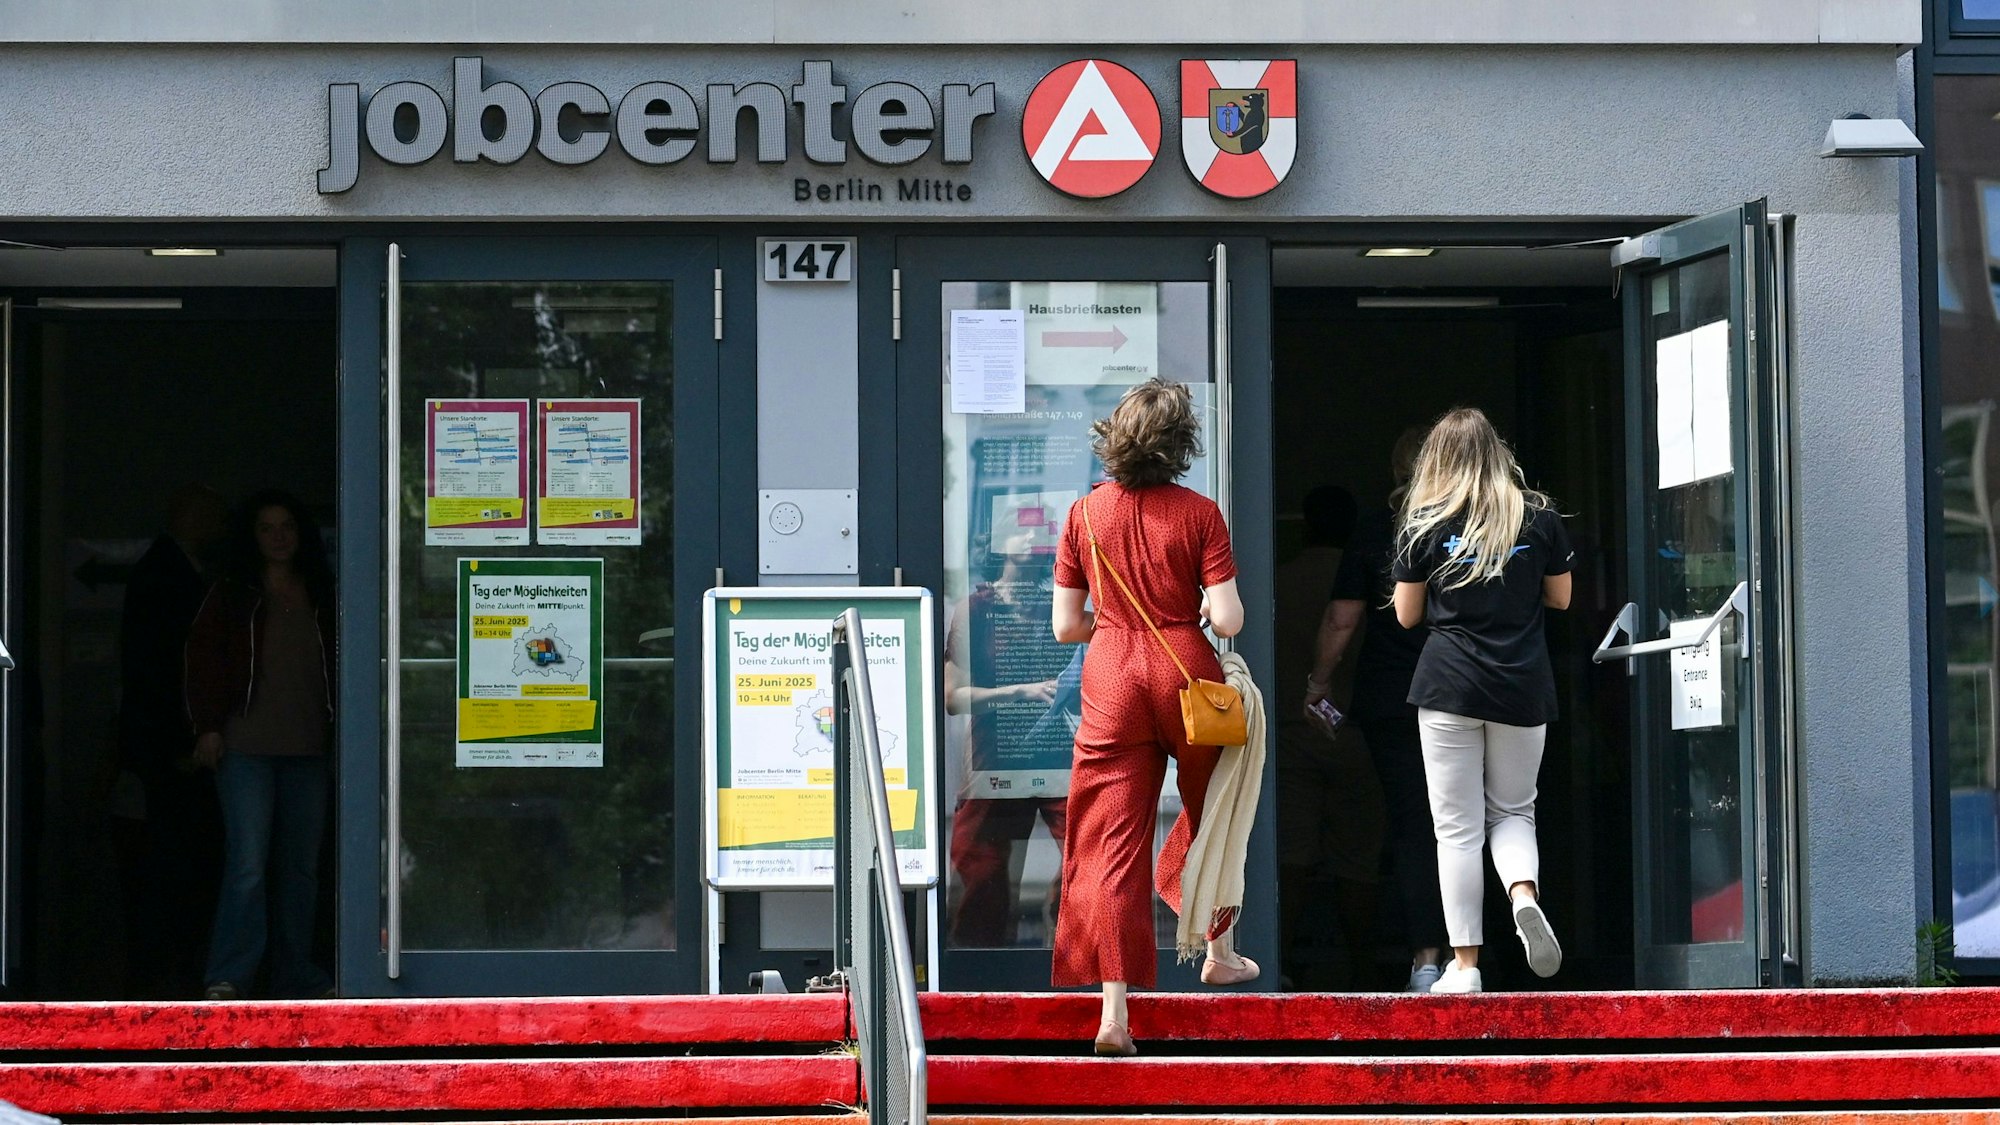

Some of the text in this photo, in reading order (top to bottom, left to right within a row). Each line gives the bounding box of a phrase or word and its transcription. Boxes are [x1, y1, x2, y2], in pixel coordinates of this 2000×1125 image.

[317, 56, 996, 193] jobcenter
[794, 179, 972, 202] Berlin Mitte
[770, 243, 845, 279] 147
[1029, 303, 1142, 315] Hausbriefkasten
[1102, 364, 1136, 373] jobcenter
[473, 584, 588, 600] Tag der Möglichkeiten
[475, 602, 585, 611] Deine Zukunft im MITTElpunkt.
[475, 617, 527, 626] 25. Juni 2025
[475, 629, 484, 637] 10
[489, 629, 498, 637] 14
[499, 629, 511, 637] Uhr
[734, 631, 901, 652] Tag der Mögleiten
[738, 656, 768, 666] Deine
[770, 655, 810, 666] Zukunft
[813, 656, 826, 666] im
[1684, 669, 1708, 682] Entrance
[738, 677, 813, 687] 25. Juni 2025
[740, 693, 751, 703] 10
[760, 693, 771, 703] 14
[774, 693, 791, 703] Uhr
